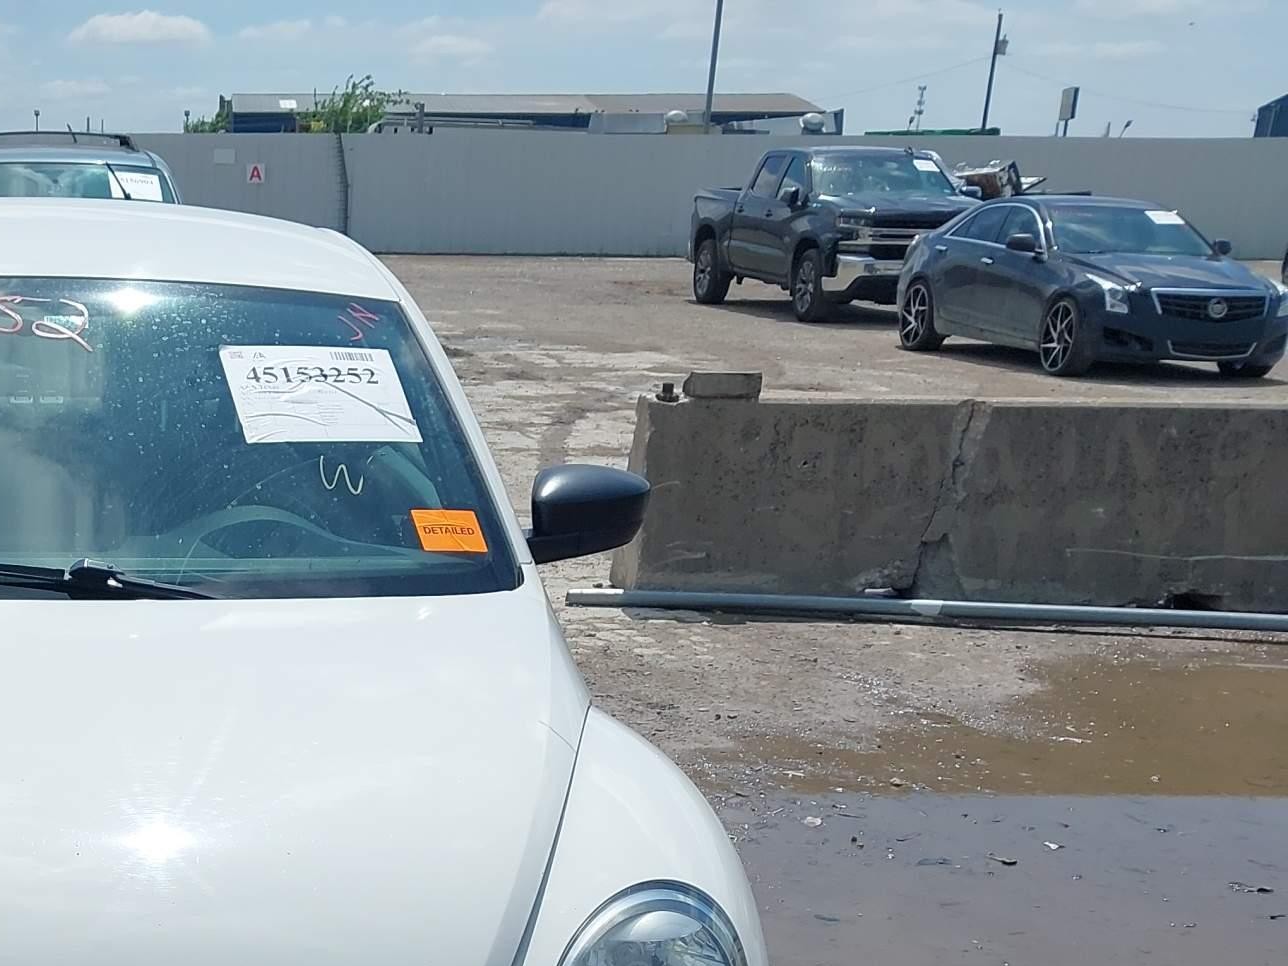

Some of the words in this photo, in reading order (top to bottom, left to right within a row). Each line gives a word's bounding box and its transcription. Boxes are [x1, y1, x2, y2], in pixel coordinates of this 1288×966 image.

[249, 165, 262, 181] A
[246, 366, 379, 385] 45153252
[422, 526, 475, 536] DETAILED
